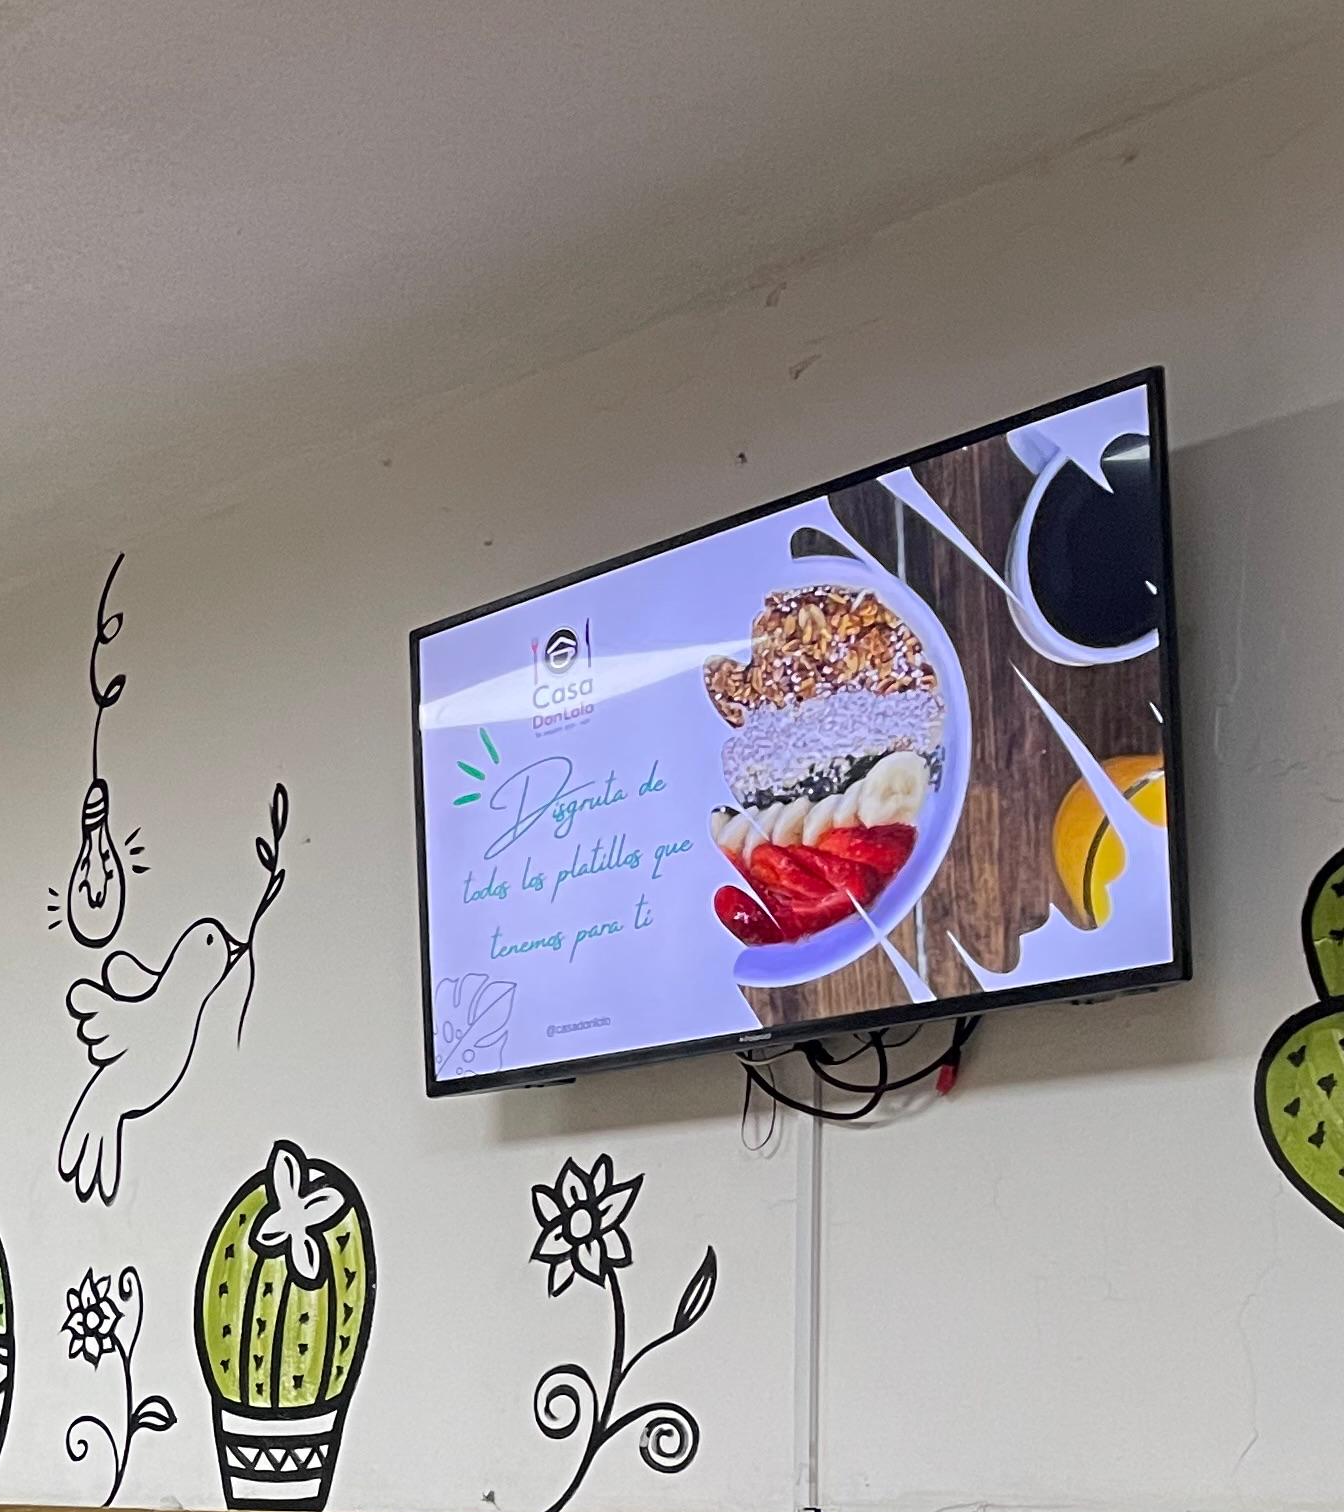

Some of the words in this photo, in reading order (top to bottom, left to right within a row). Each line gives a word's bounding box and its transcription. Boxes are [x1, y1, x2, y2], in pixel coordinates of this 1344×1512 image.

[532, 678, 594, 709] Casa
[638, 759, 668, 797] de
[463, 866, 511, 904] todos
[521, 857, 548, 891] los
[550, 833, 645, 904] platillos
[651, 839, 695, 880] que
[490, 926, 565, 960] tenemos
[568, 920, 625, 964] para
[634, 893, 654, 930] ti
